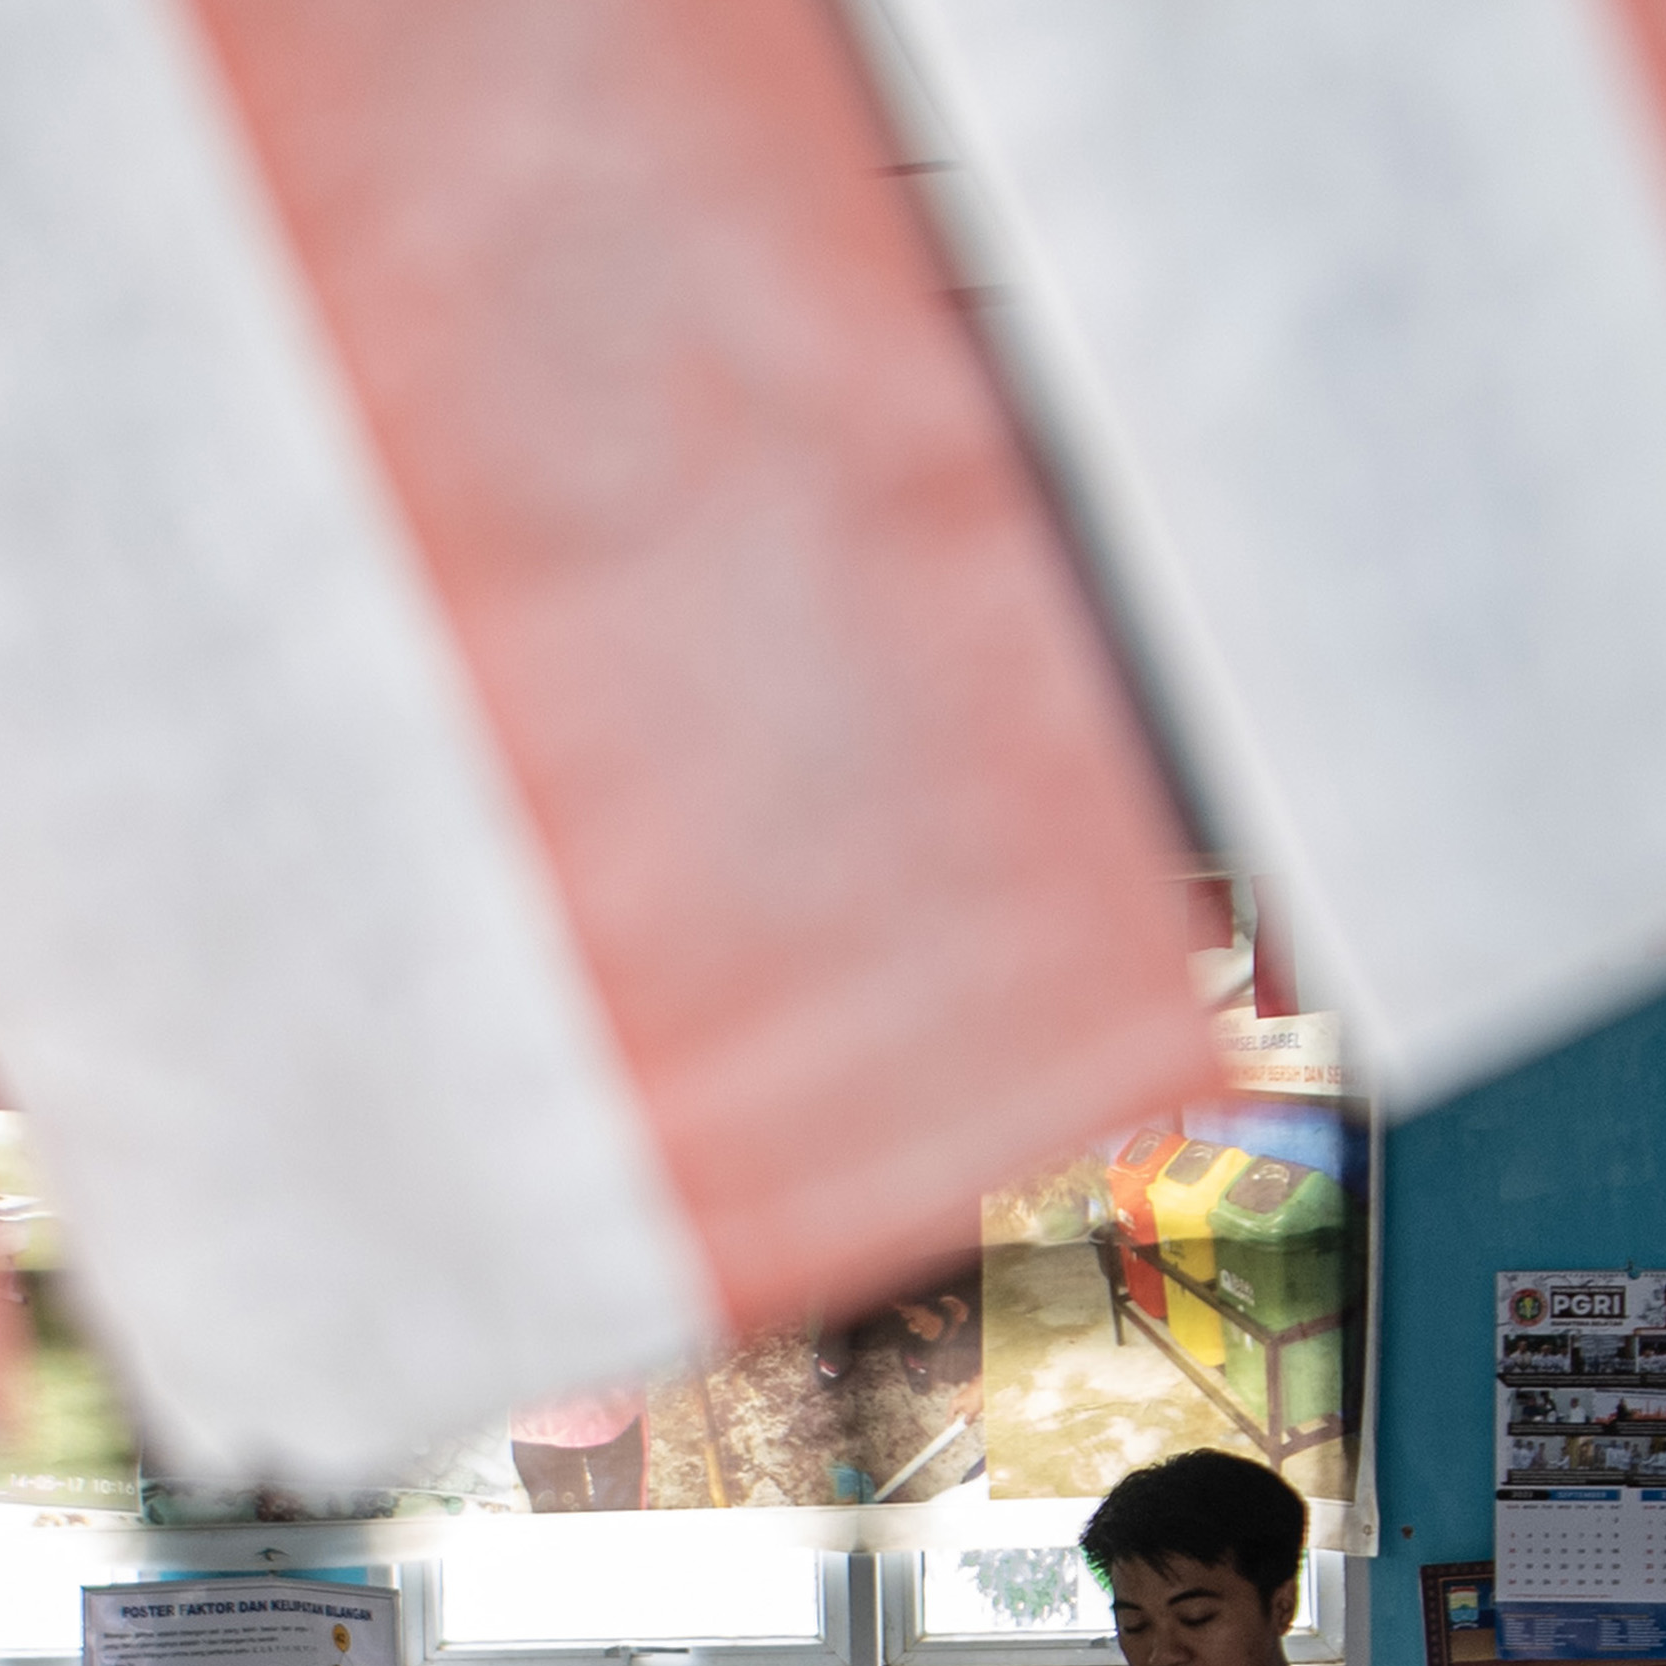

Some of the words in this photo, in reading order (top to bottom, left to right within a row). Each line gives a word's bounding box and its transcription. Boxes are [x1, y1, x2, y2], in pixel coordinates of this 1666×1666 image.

[1261, 1033, 1302, 1051] BABEL
[1303, 1066, 1324, 1084] DAN
[1553, 1294, 1621, 1316] PGRI
[122, 1605, 176, 1619] POSTER
[179, 1602, 236, 1617] FAKTOR
[238, 1600, 268, 1614] DAN
[270, 1599, 324, 1616] KELIPATAN
[325, 1604, 373, 1622] BILANGAN
